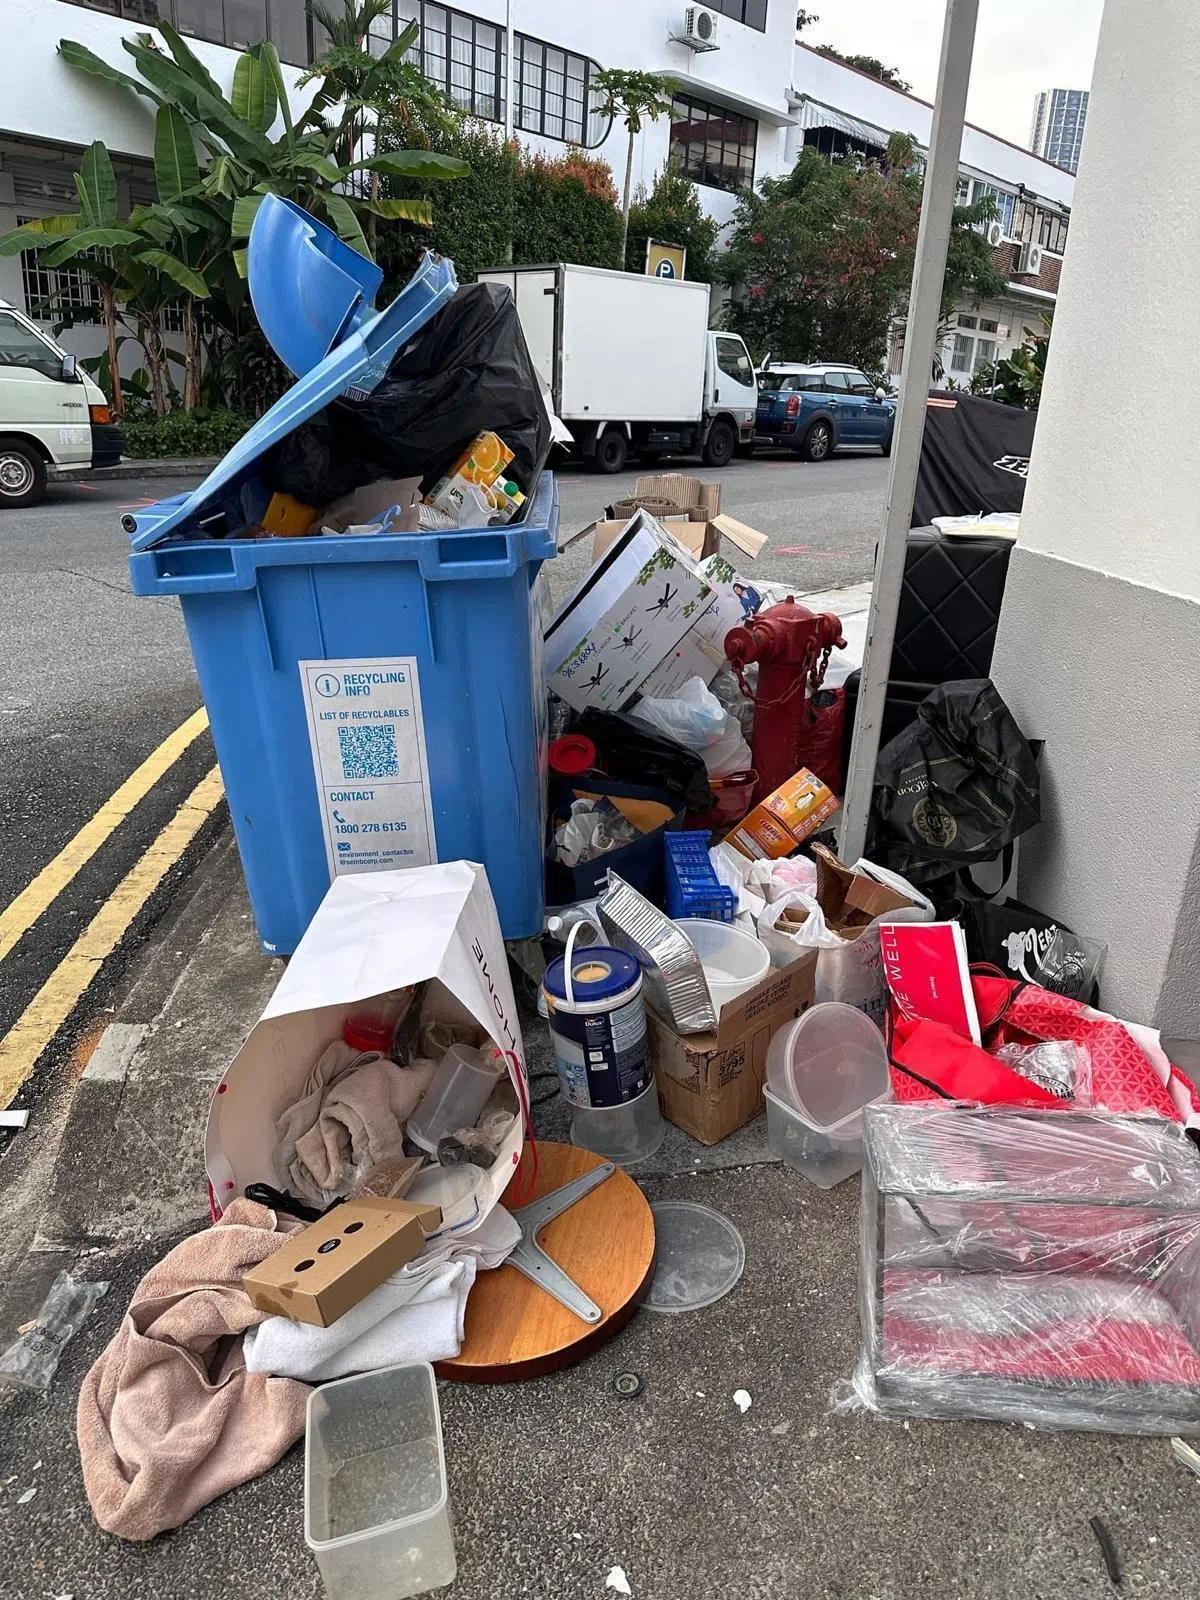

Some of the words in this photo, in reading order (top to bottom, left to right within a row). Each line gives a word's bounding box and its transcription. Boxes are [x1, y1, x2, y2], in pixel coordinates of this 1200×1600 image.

[343, 672, 405, 685] RECYCLING
[345, 685, 371, 697] INFO
[319, 712, 338, 720] LIST
[340, 711, 350, 720] OF
[352, 709, 410, 719] RECYCLABLES
[330, 791, 375, 802] CONTACT
[335, 824, 359, 834] 1800
[361, 823, 380, 833] 278
[382, 822, 407, 832] 6135
[338, 849, 414, 858] environment_contactus
[340, 857, 394, 866] @sembcorp.com
[883, 925, 903, 981] WELL
[472, 936, 517, 1050] HOME
